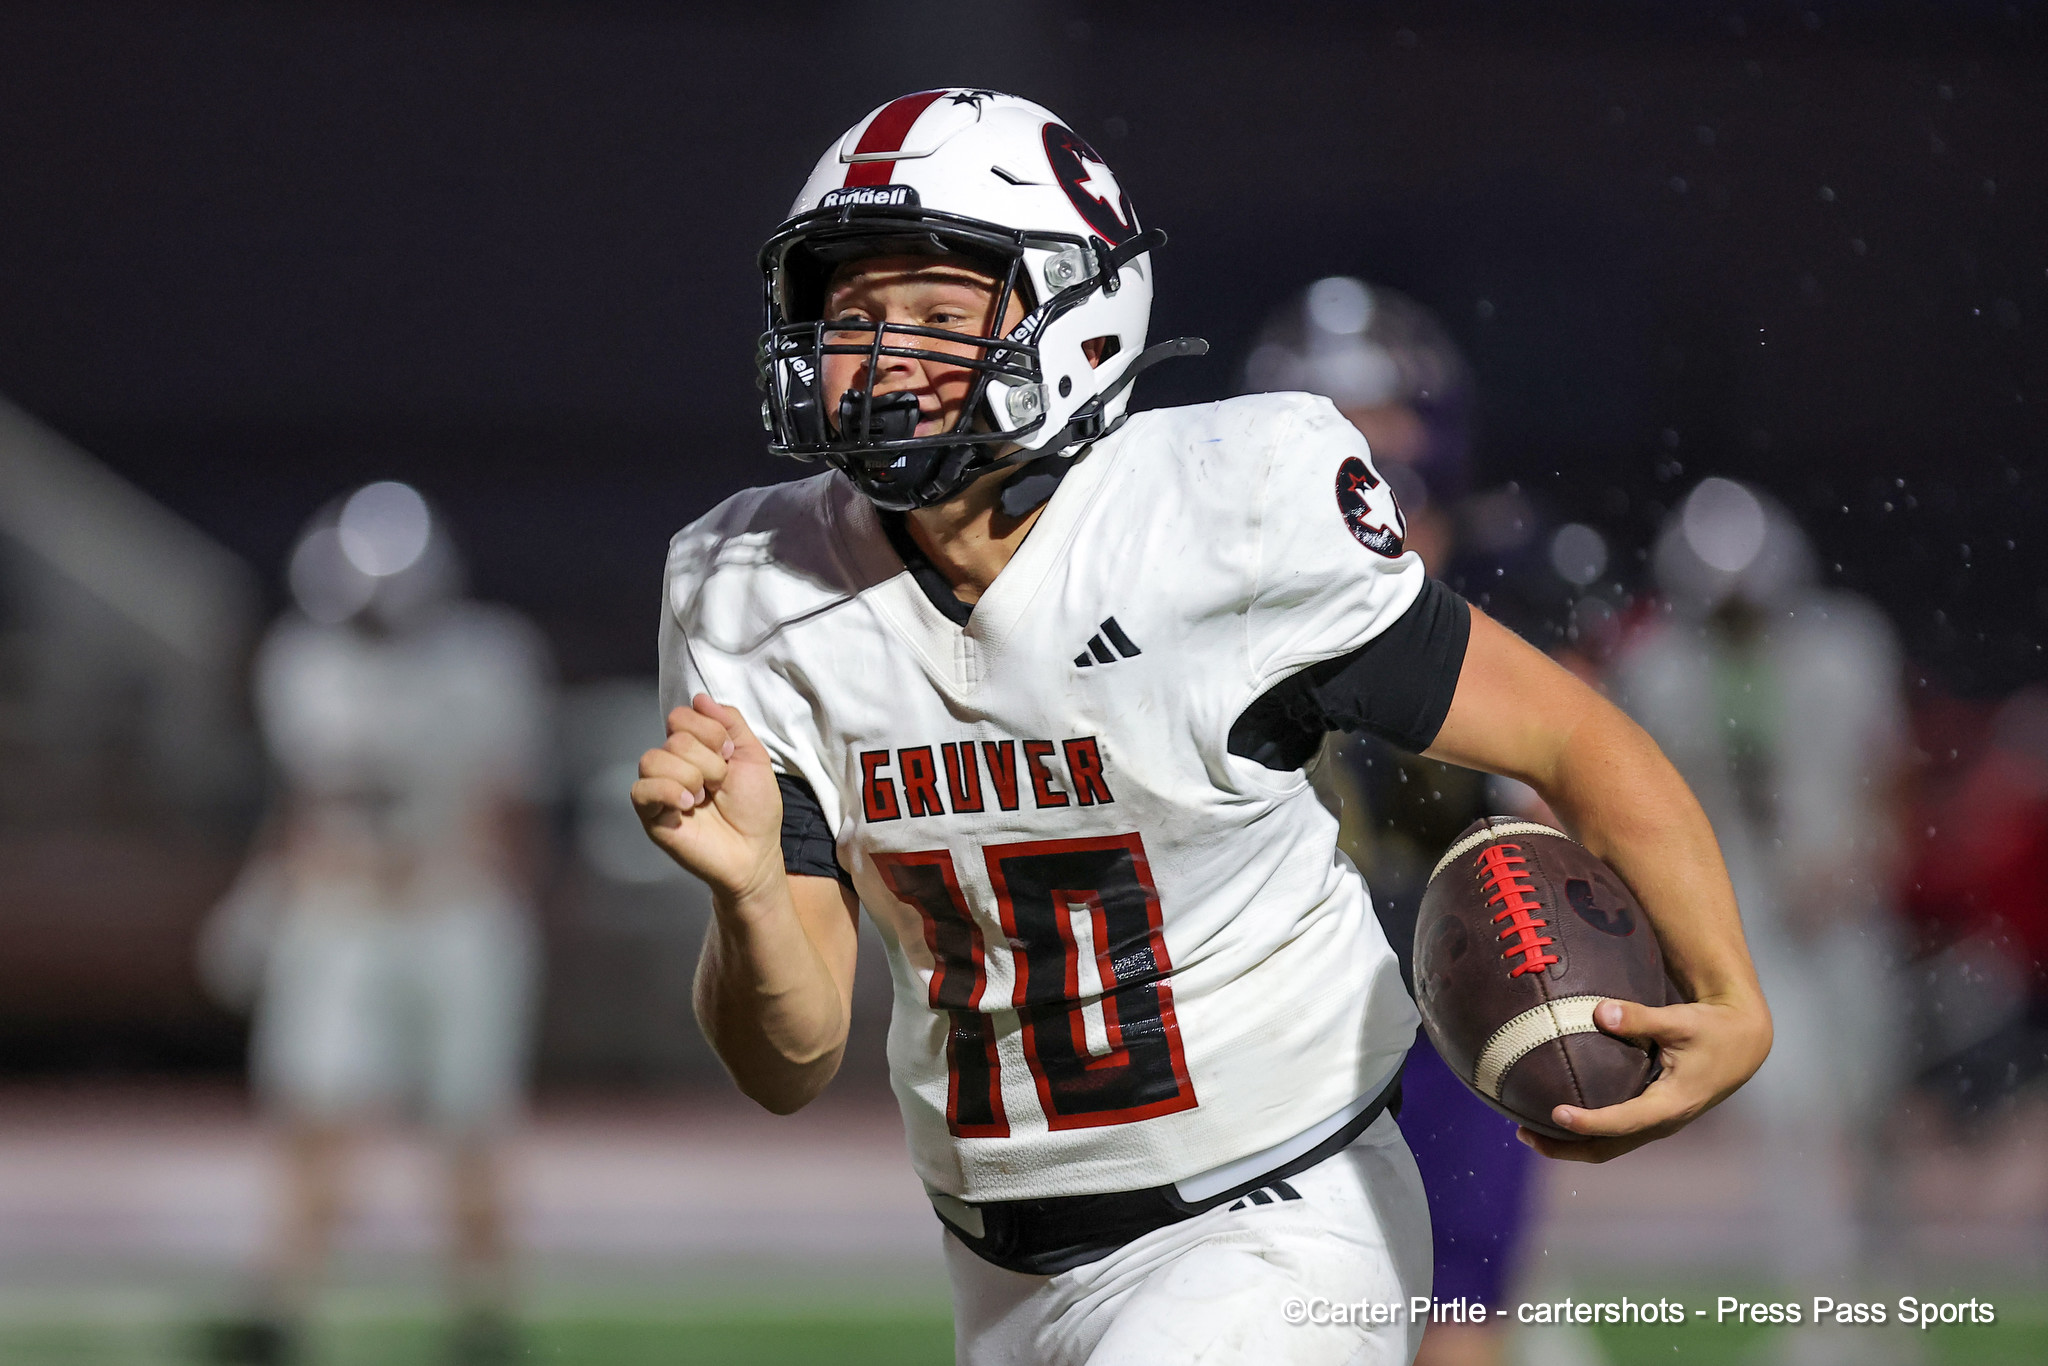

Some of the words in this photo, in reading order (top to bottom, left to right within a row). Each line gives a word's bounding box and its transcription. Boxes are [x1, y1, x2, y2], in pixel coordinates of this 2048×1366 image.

[823, 187, 908, 208] Riddell
[860, 736, 1115, 823] GRUVER
[869, 832, 1199, 1138] 10
